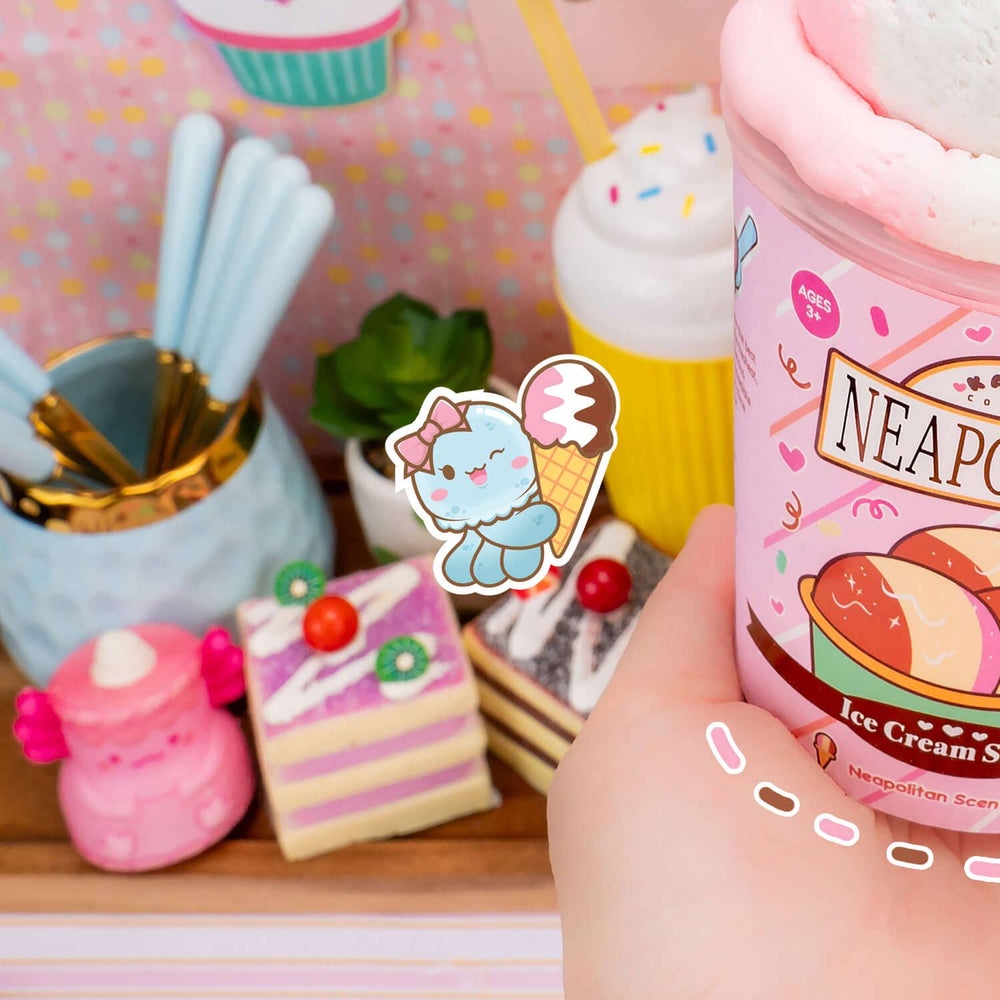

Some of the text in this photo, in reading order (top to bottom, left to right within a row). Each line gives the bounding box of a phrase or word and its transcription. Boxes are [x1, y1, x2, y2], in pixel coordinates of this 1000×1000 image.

[798, 284, 832, 313] AGES
[806, 305, 821, 322] 3+
[839, 697, 879, 732] Ice
[884, 722, 975, 761] Cream
[848, 764, 947, 802] Neapolitan
